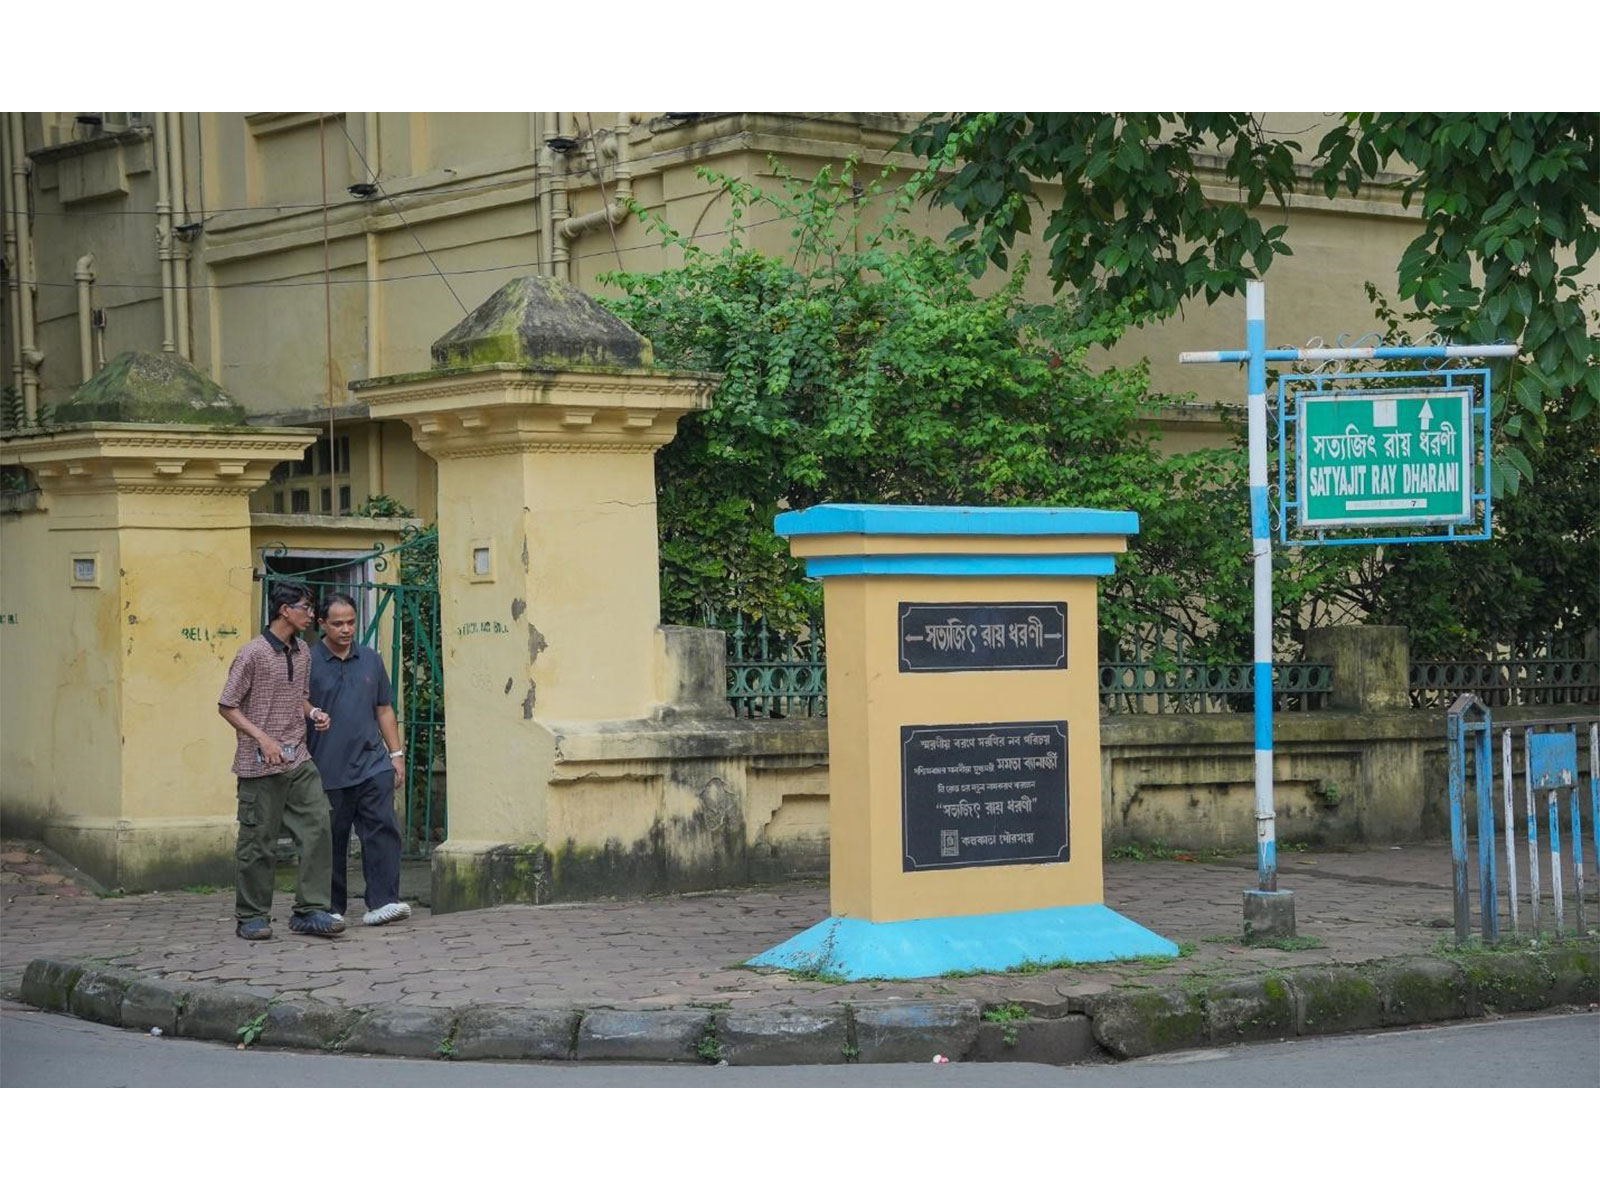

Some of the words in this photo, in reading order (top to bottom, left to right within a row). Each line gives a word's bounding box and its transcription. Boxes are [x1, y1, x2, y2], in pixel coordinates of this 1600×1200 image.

[1311, 423, 1378, 461] সত্যজিৎ
[1382, 429, 1412, 459] রায়
[1419, 421, 1457, 458] ধরণী
[1310, 465, 1367, 496] SATYAJIT
[1371, 464, 1398, 495] RAY
[1402, 462, 1459, 494] DHARANI
[924, 617, 978, 653] সত্যজিৎ
[980, 623, 1006, 649] রায়
[1008, 615, 1044, 649] ধরণী
[996, 756, 1022, 771] মমতা
[984, 801, 1004, 816] রায়
